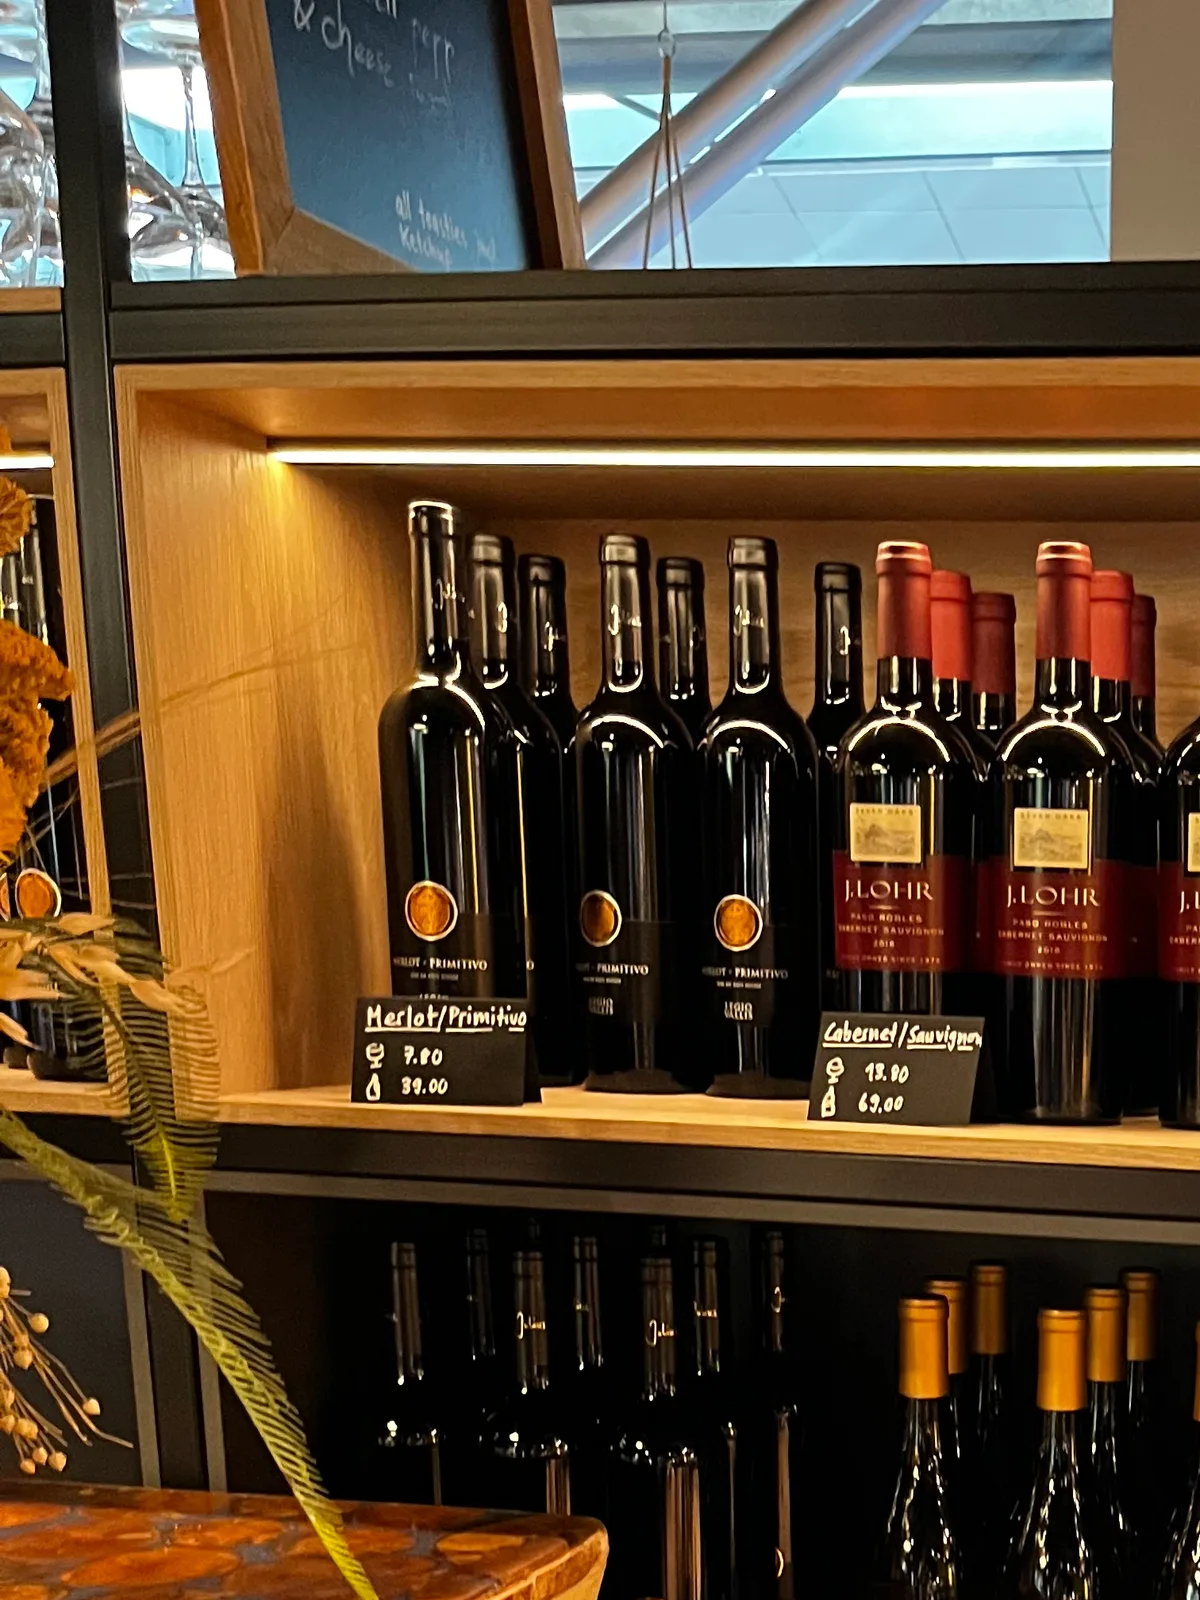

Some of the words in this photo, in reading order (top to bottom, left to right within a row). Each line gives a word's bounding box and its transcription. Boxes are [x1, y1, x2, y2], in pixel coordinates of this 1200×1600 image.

[430, 957, 488, 971] PRIMITIVO
[597, 964, 649, 975] PRIMITIVO
[734, 966, 788, 979] PRIMITIVO
[403, 1045, 443, 1066] 7.80
[402, 1077, 448, 1096] 39.00
[858, 1095, 904, 1114] 69.00
